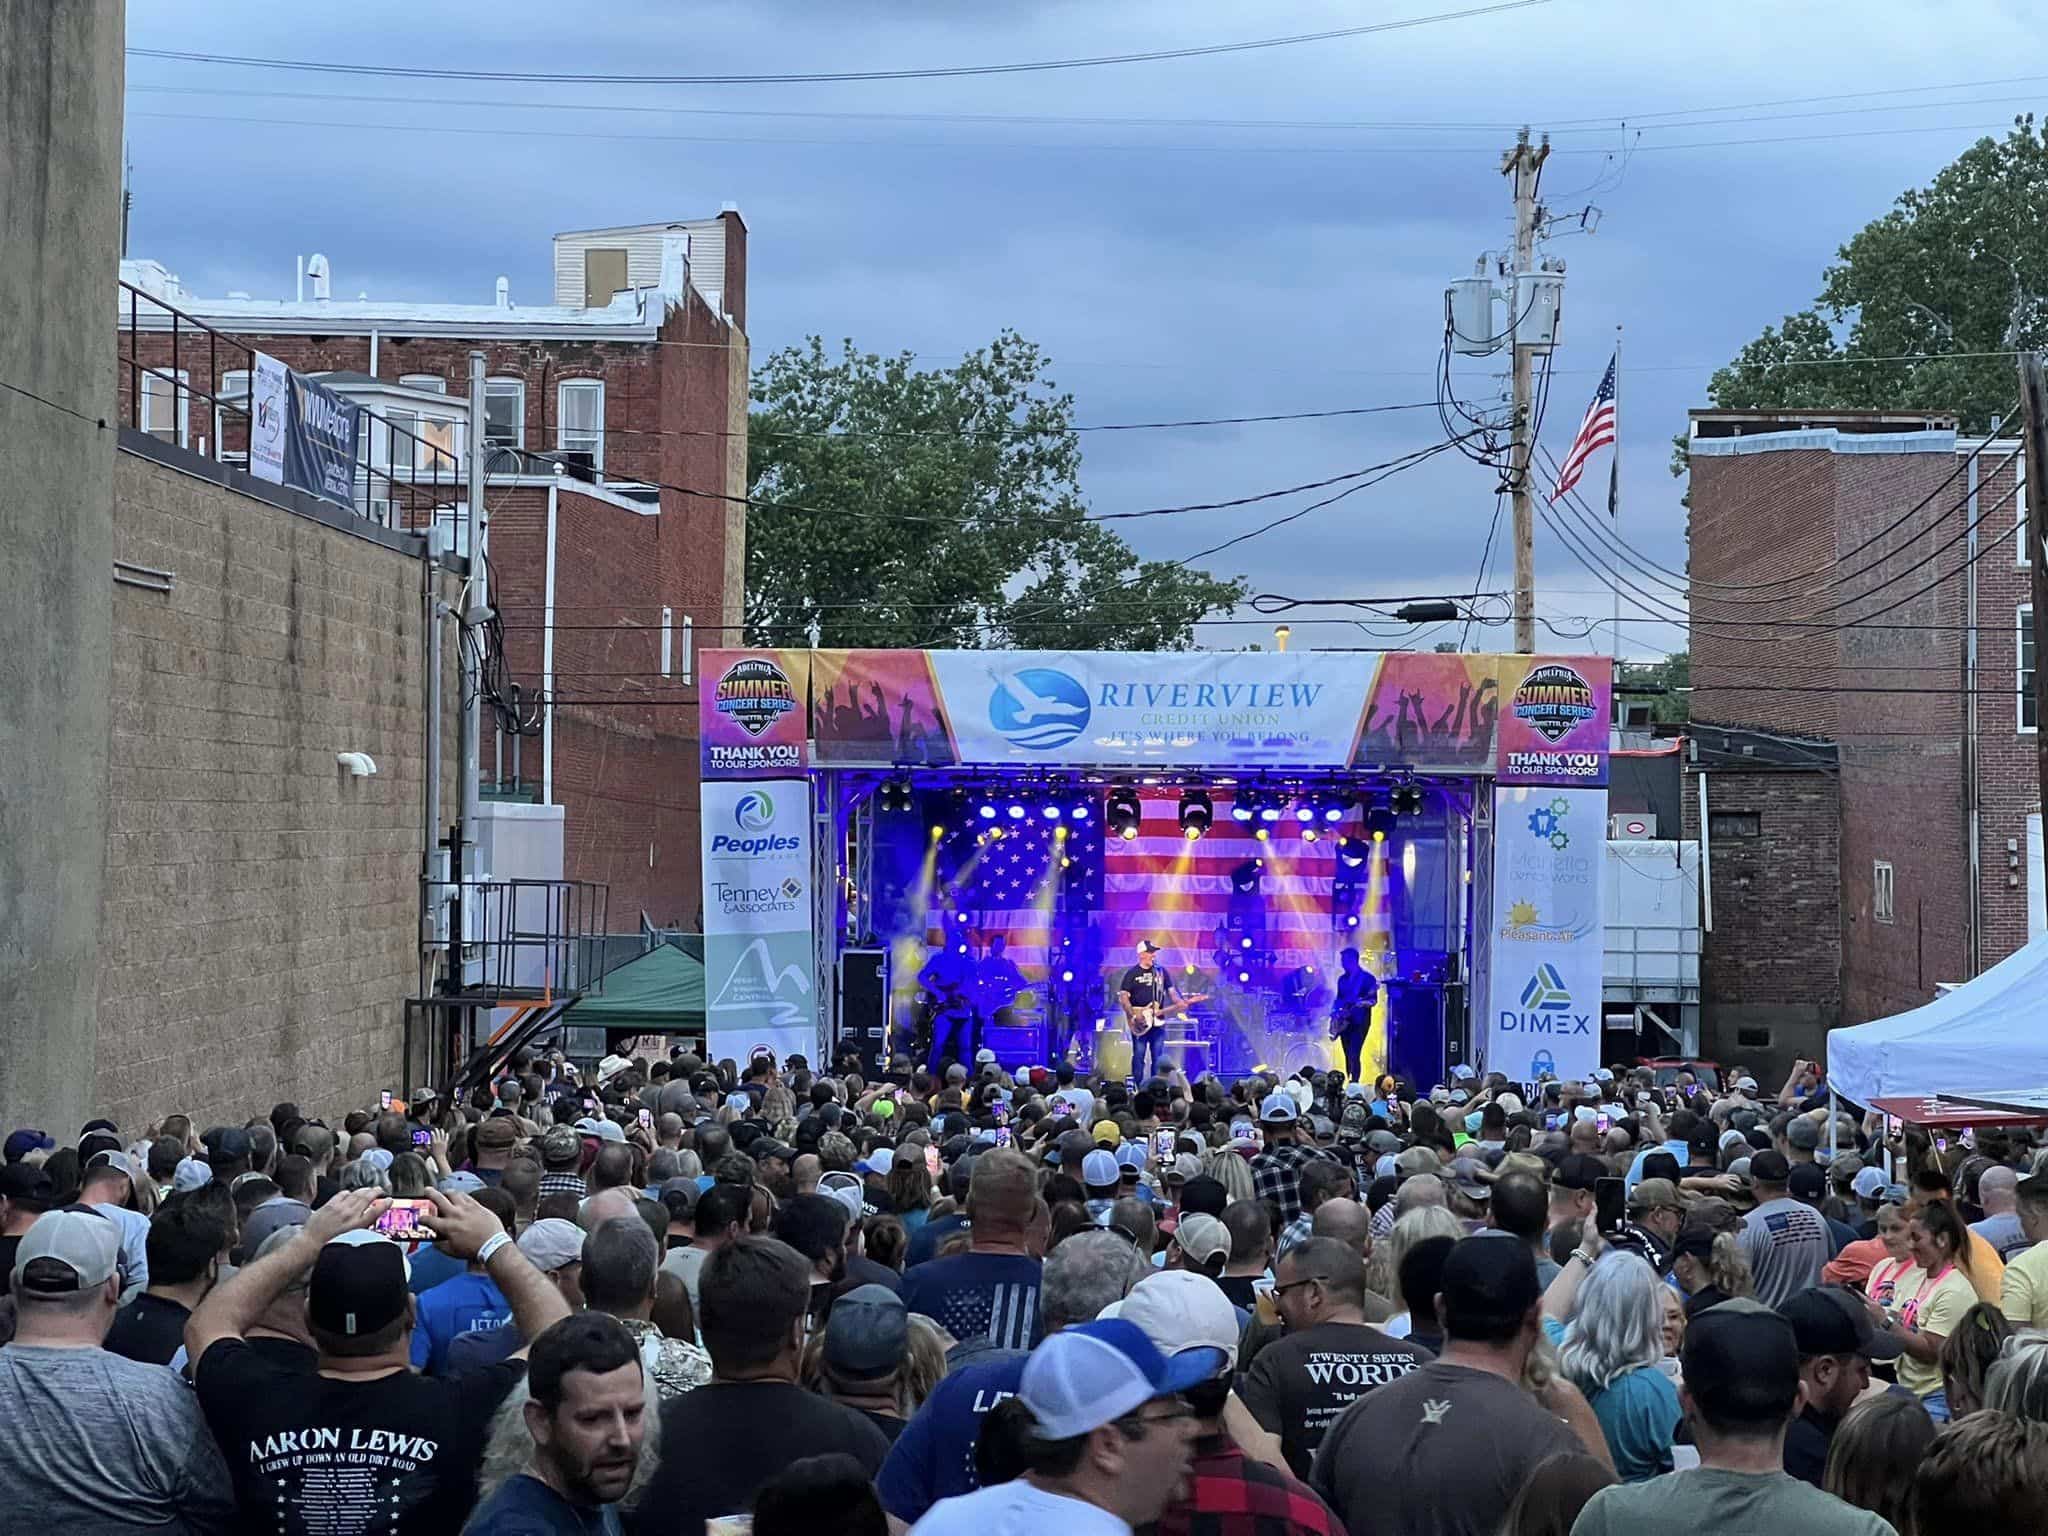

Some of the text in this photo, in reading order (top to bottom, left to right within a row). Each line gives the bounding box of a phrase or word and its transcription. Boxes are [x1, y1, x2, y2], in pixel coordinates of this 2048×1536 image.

[716, 680, 794, 700] SUMMER
[1098, 683, 1324, 708] RIVERVIEW
[1515, 685, 1594, 705] SUMMER
[717, 698, 794, 711] CONCERT SERIES
[1514, 704, 1595, 718] CONCERT SERIES
[1140, 712, 1281, 726] CREDIT UNION
[1148, 731, 1205, 743] WHERE
[1212, 731, 1241, 743] YOU
[710, 745, 800, 760] THANK YOU
[1507, 752, 1599, 767] THANK YOU
[711, 759, 723, 769] TO
[725, 759, 746, 769] OUR
[1508, 765, 1599, 776] TO OUR SPONSORS!
[711, 834, 800, 856] Peoples
[711, 882, 779, 904] Tenney
[1500, 1011, 1590, 1035] DIMEX
[1310, 1352, 1415, 1364] TWENTY SEVEN
[250, 1427, 438, 1463] AARON LEWIS
[260, 1452, 417, 1474] I GREW UP DOWN AN OLD DIRT ROAD
